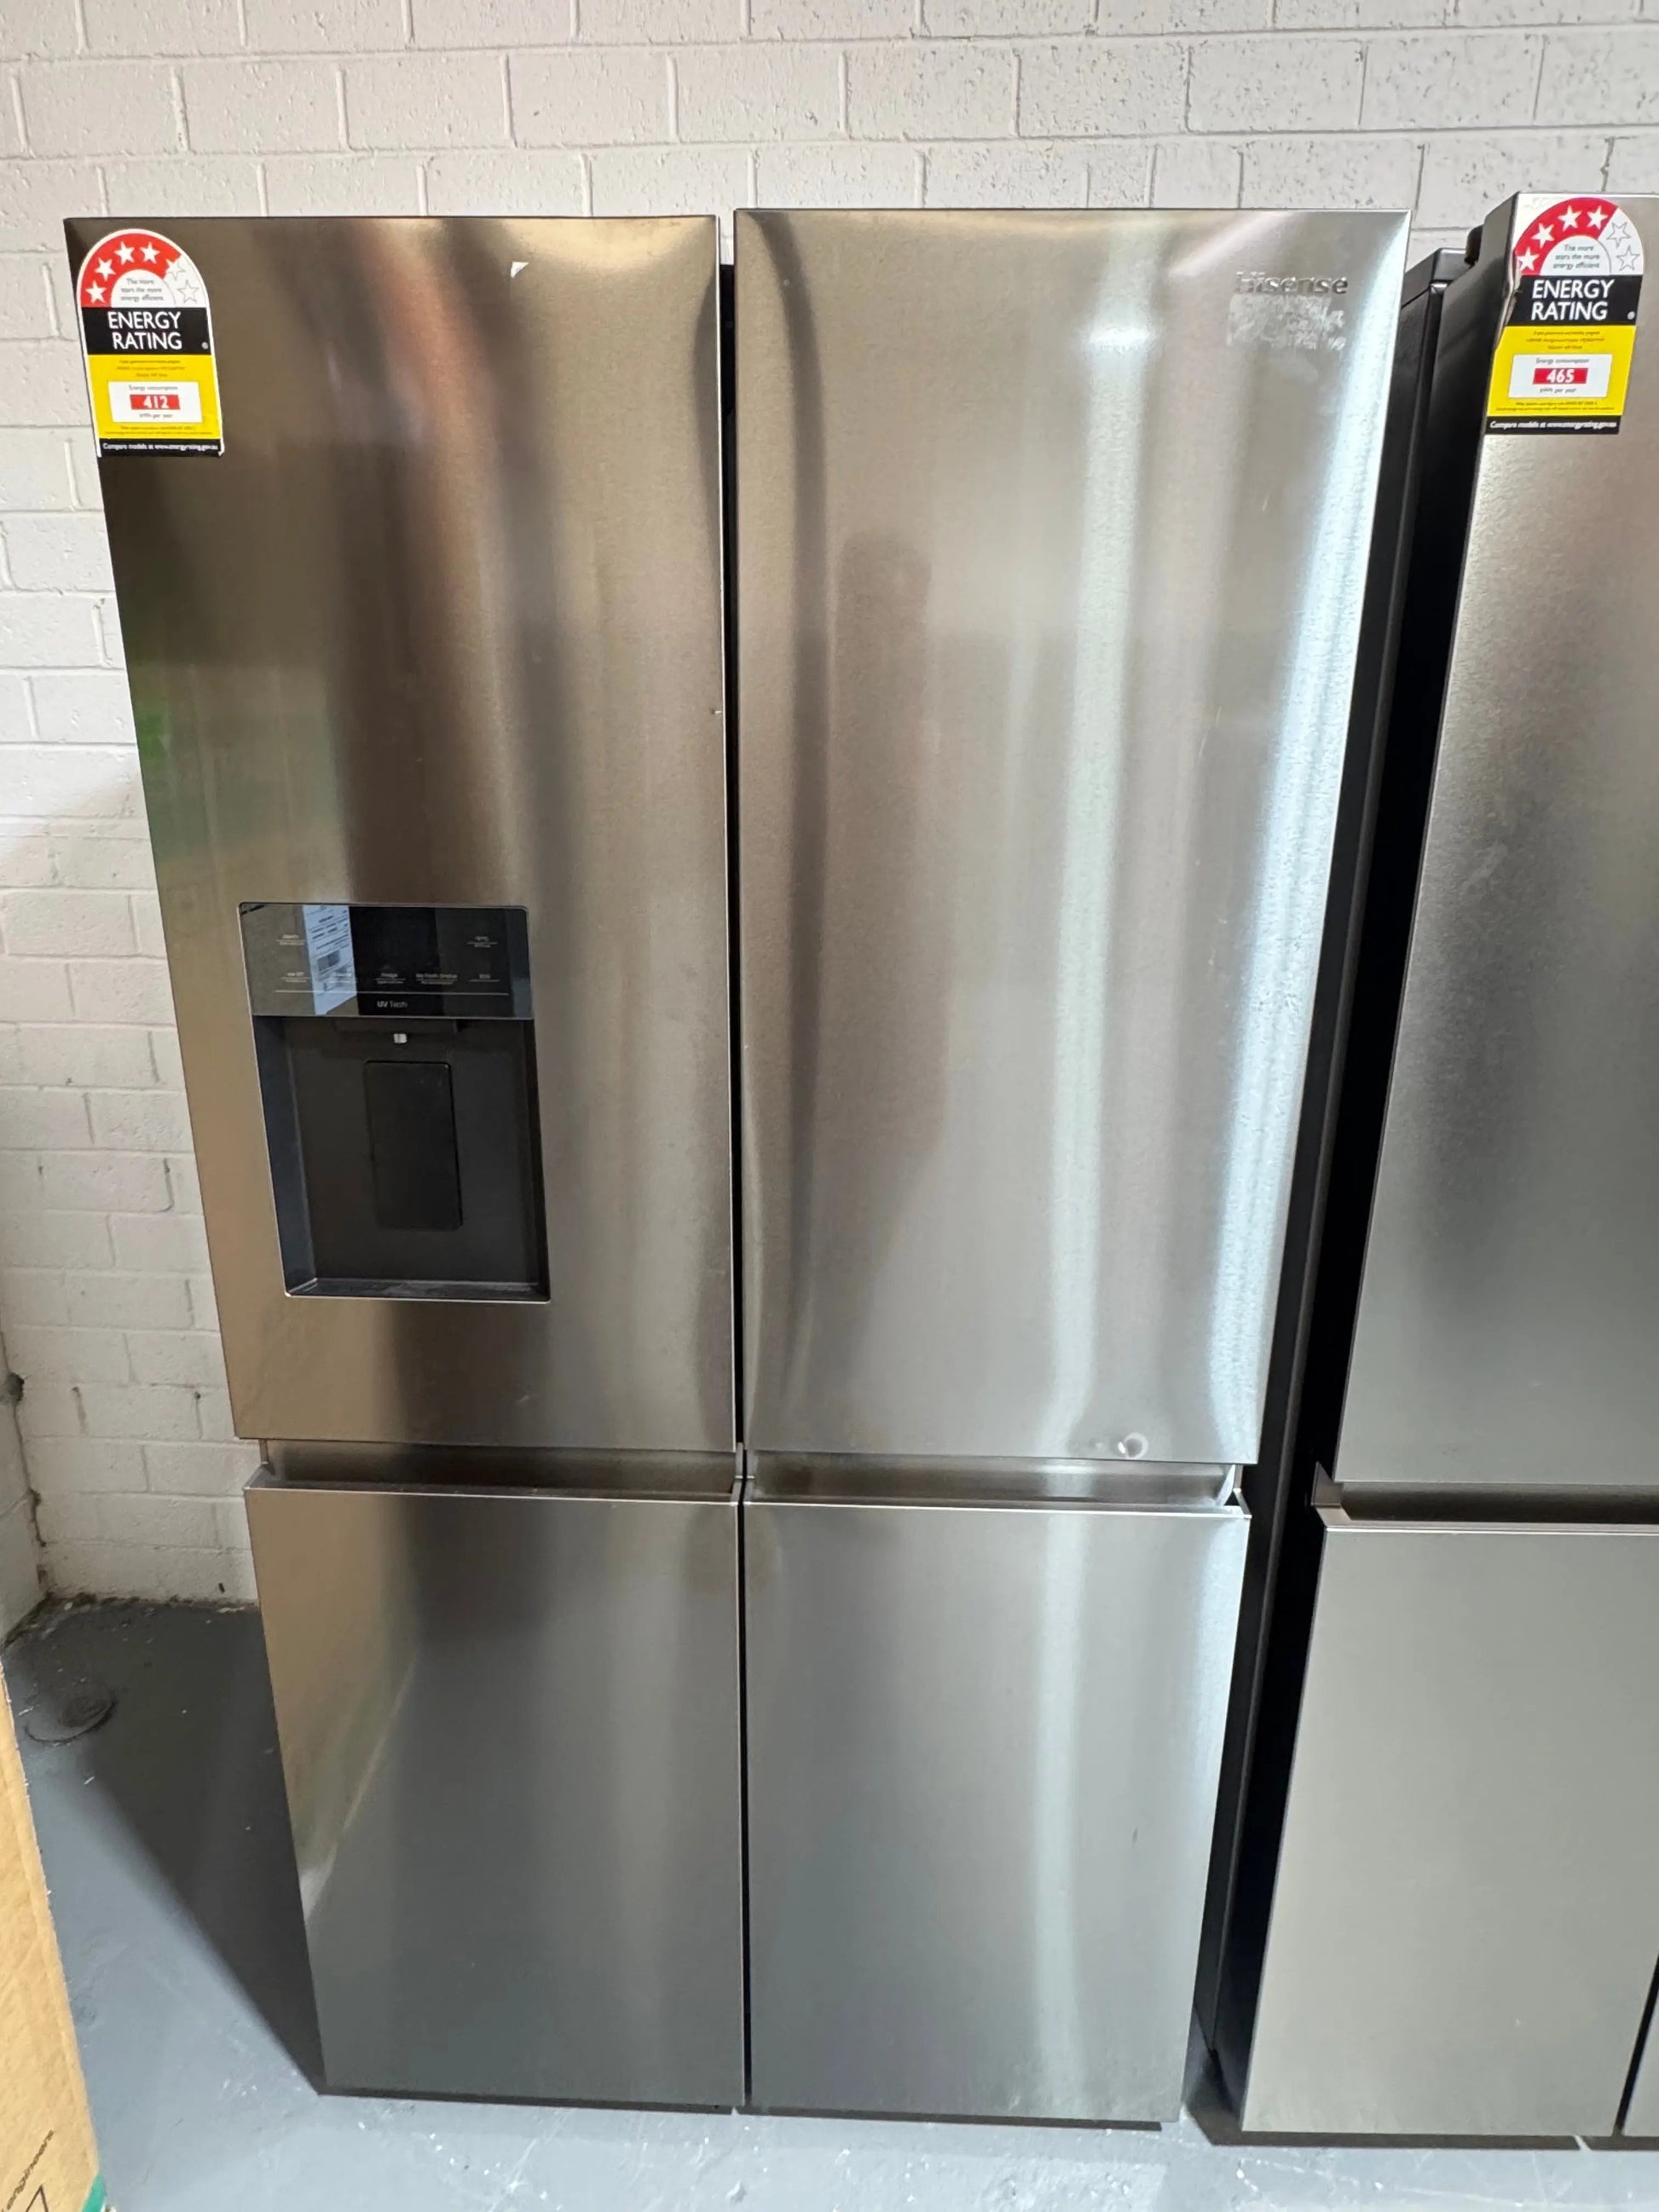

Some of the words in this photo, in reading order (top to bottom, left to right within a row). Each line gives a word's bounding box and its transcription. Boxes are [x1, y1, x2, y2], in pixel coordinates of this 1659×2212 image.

[1532, 279, 1616, 299] ENERGY
[1530, 301, 1609, 321] RATING
[107, 311, 181, 330] ENERGY
[112, 332, 182, 350] RATING
[1546, 368, 1575, 384] 465
[143, 395, 170, 410] 412
